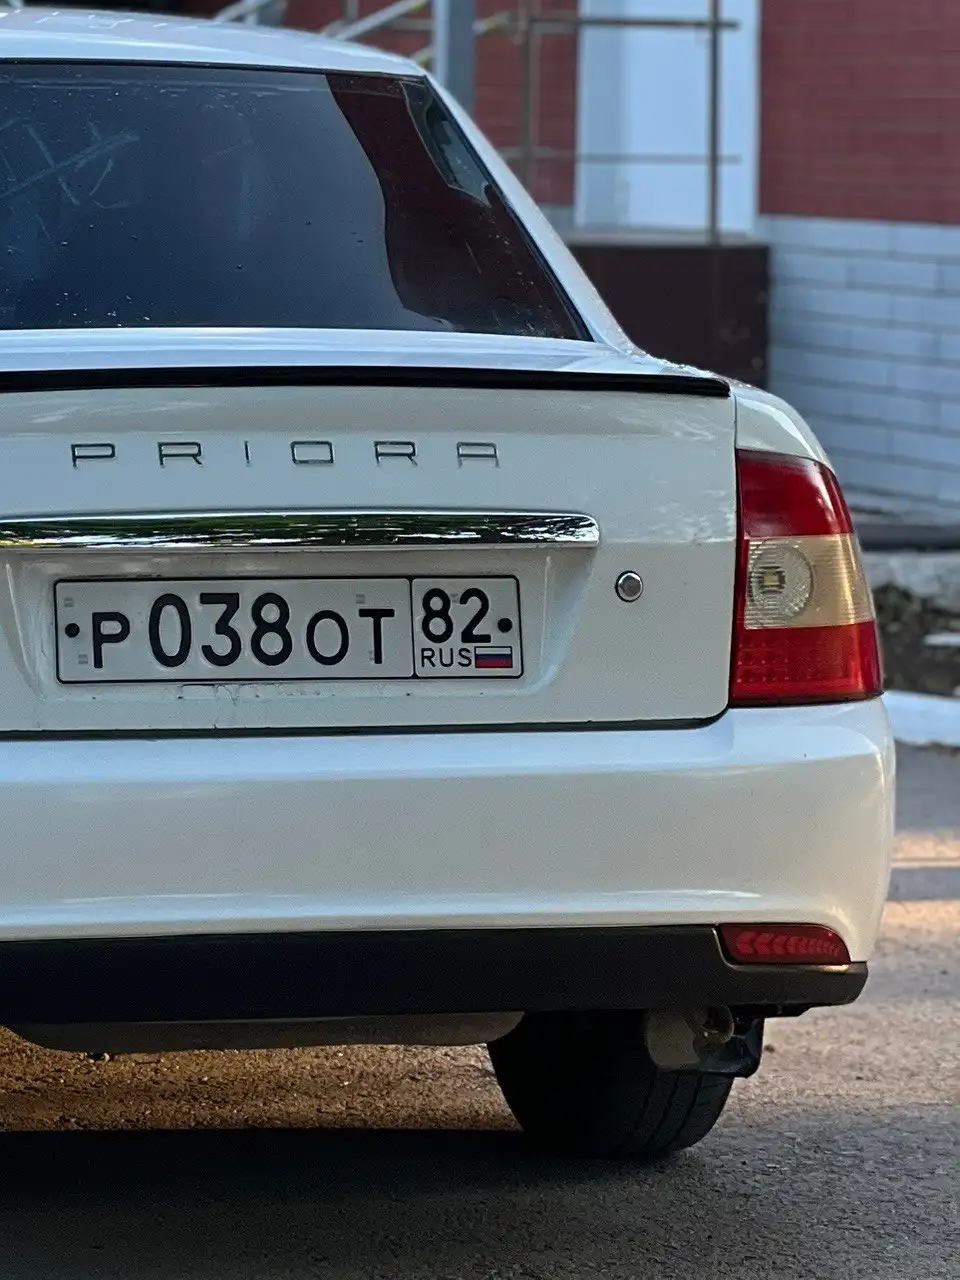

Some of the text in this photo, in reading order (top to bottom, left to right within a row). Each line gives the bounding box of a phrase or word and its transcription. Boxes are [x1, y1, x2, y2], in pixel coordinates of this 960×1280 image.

[71, 440, 500, 468] PRIORA
[421, 587, 492, 645] 82
[420, 647, 472, 669] RUS
